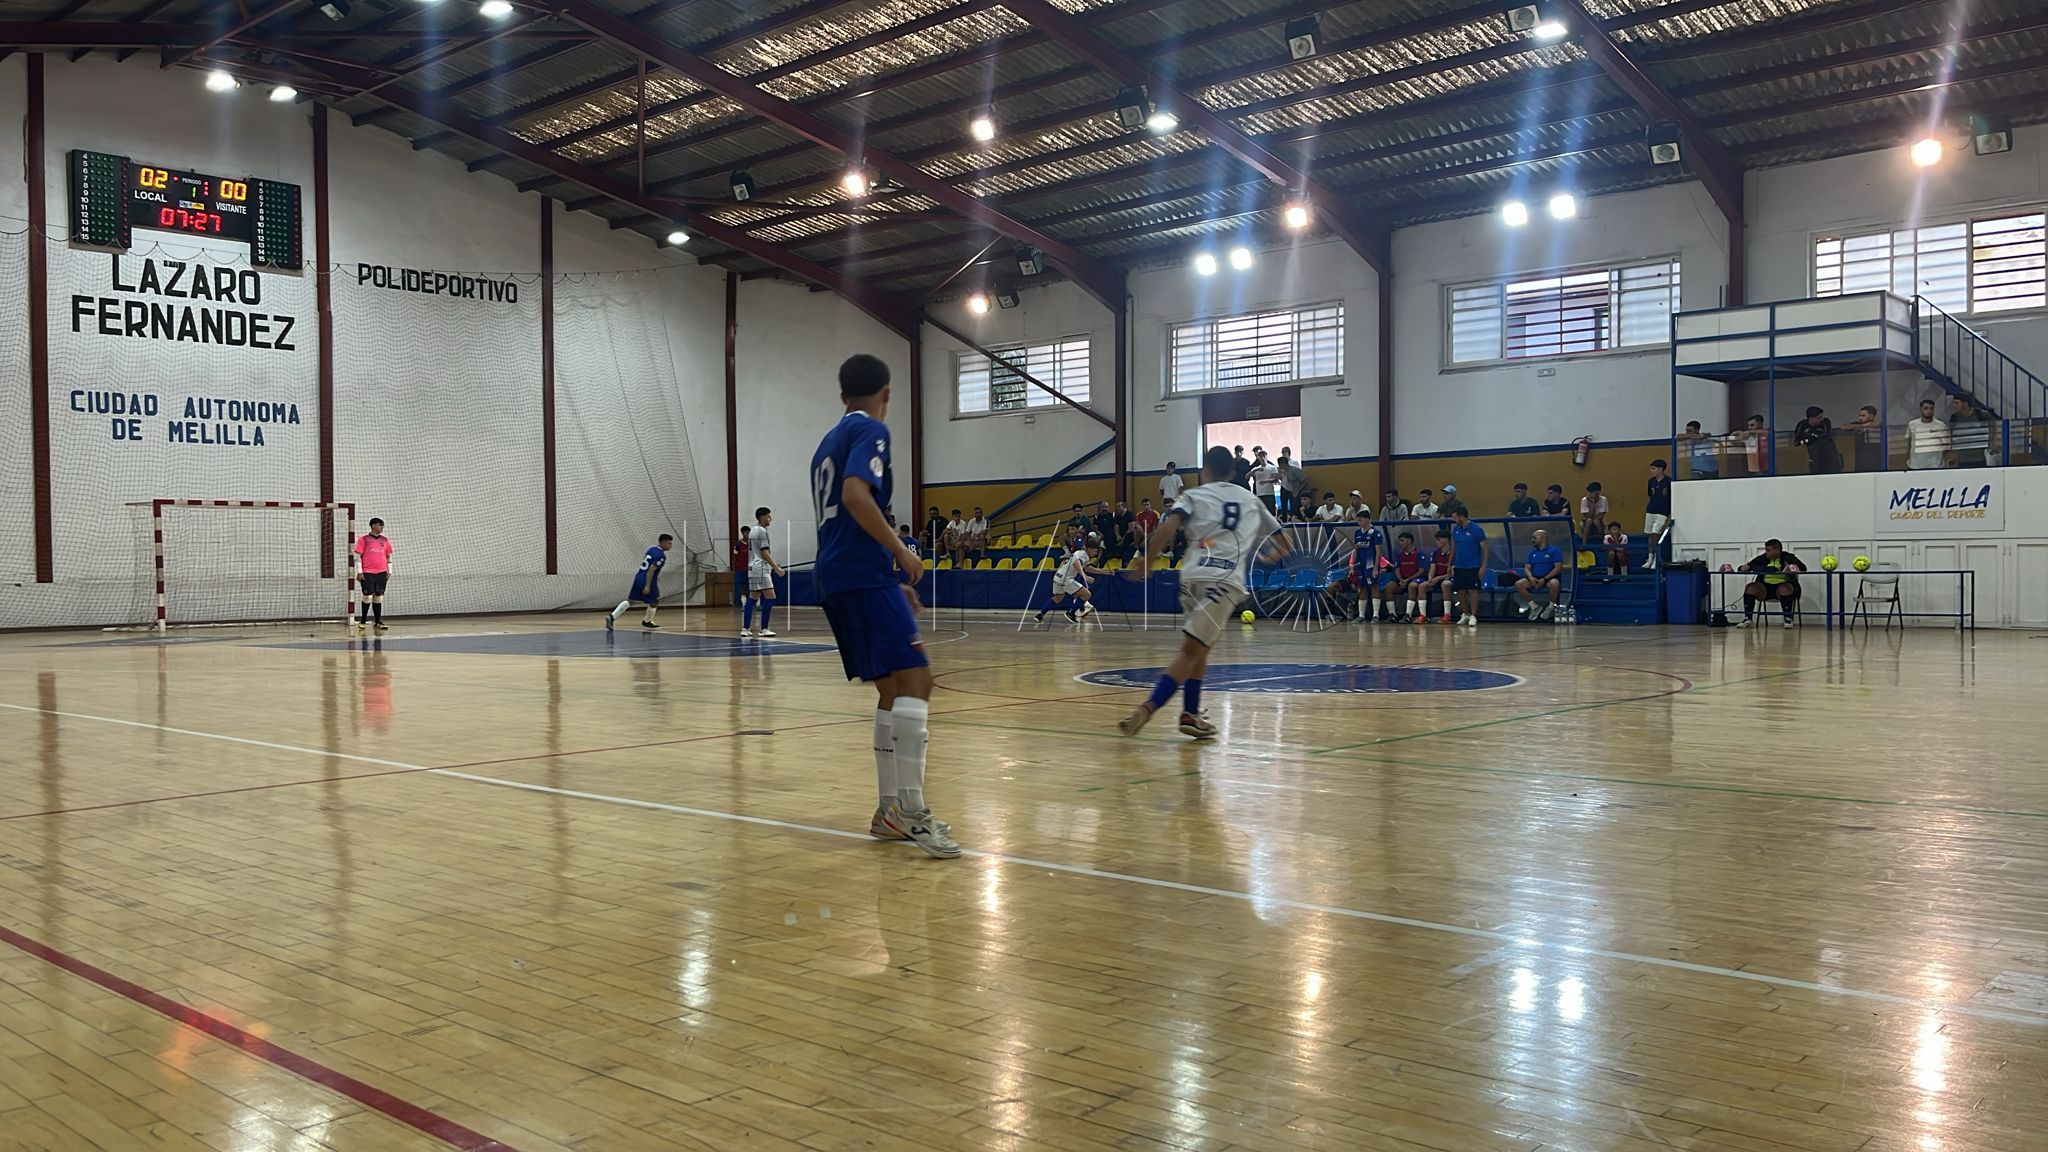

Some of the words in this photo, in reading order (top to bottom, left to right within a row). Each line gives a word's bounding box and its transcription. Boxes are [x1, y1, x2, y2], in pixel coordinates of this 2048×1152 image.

[140, 168, 168, 189] 02
[220, 180, 247, 201] 00
[134, 190, 167, 203] LOCAL
[192, 187, 196, 198] 1
[161, 207, 223, 232] 07:27
[215, 202, 247, 214] VISITANTE
[112, 254, 261, 306] LAZARO
[358, 262, 518, 304] POLIDEPORTIVO
[72, 294, 295, 351] FERNANDEZ
[70, 390, 158, 416] CIUDAD
[184, 396, 300, 425] AUTONOMA
[112, 418, 143, 441] DE
[168, 420, 265, 447] MELILLA
[1889, 484, 1991, 511] MELILLA
[1222, 502, 1241, 531] 8
[1889, 511, 1923, 520] CIUDAD
[1926, 510, 1944, 520] DEL
[1947, 509, 1986, 519] DEPORTE
